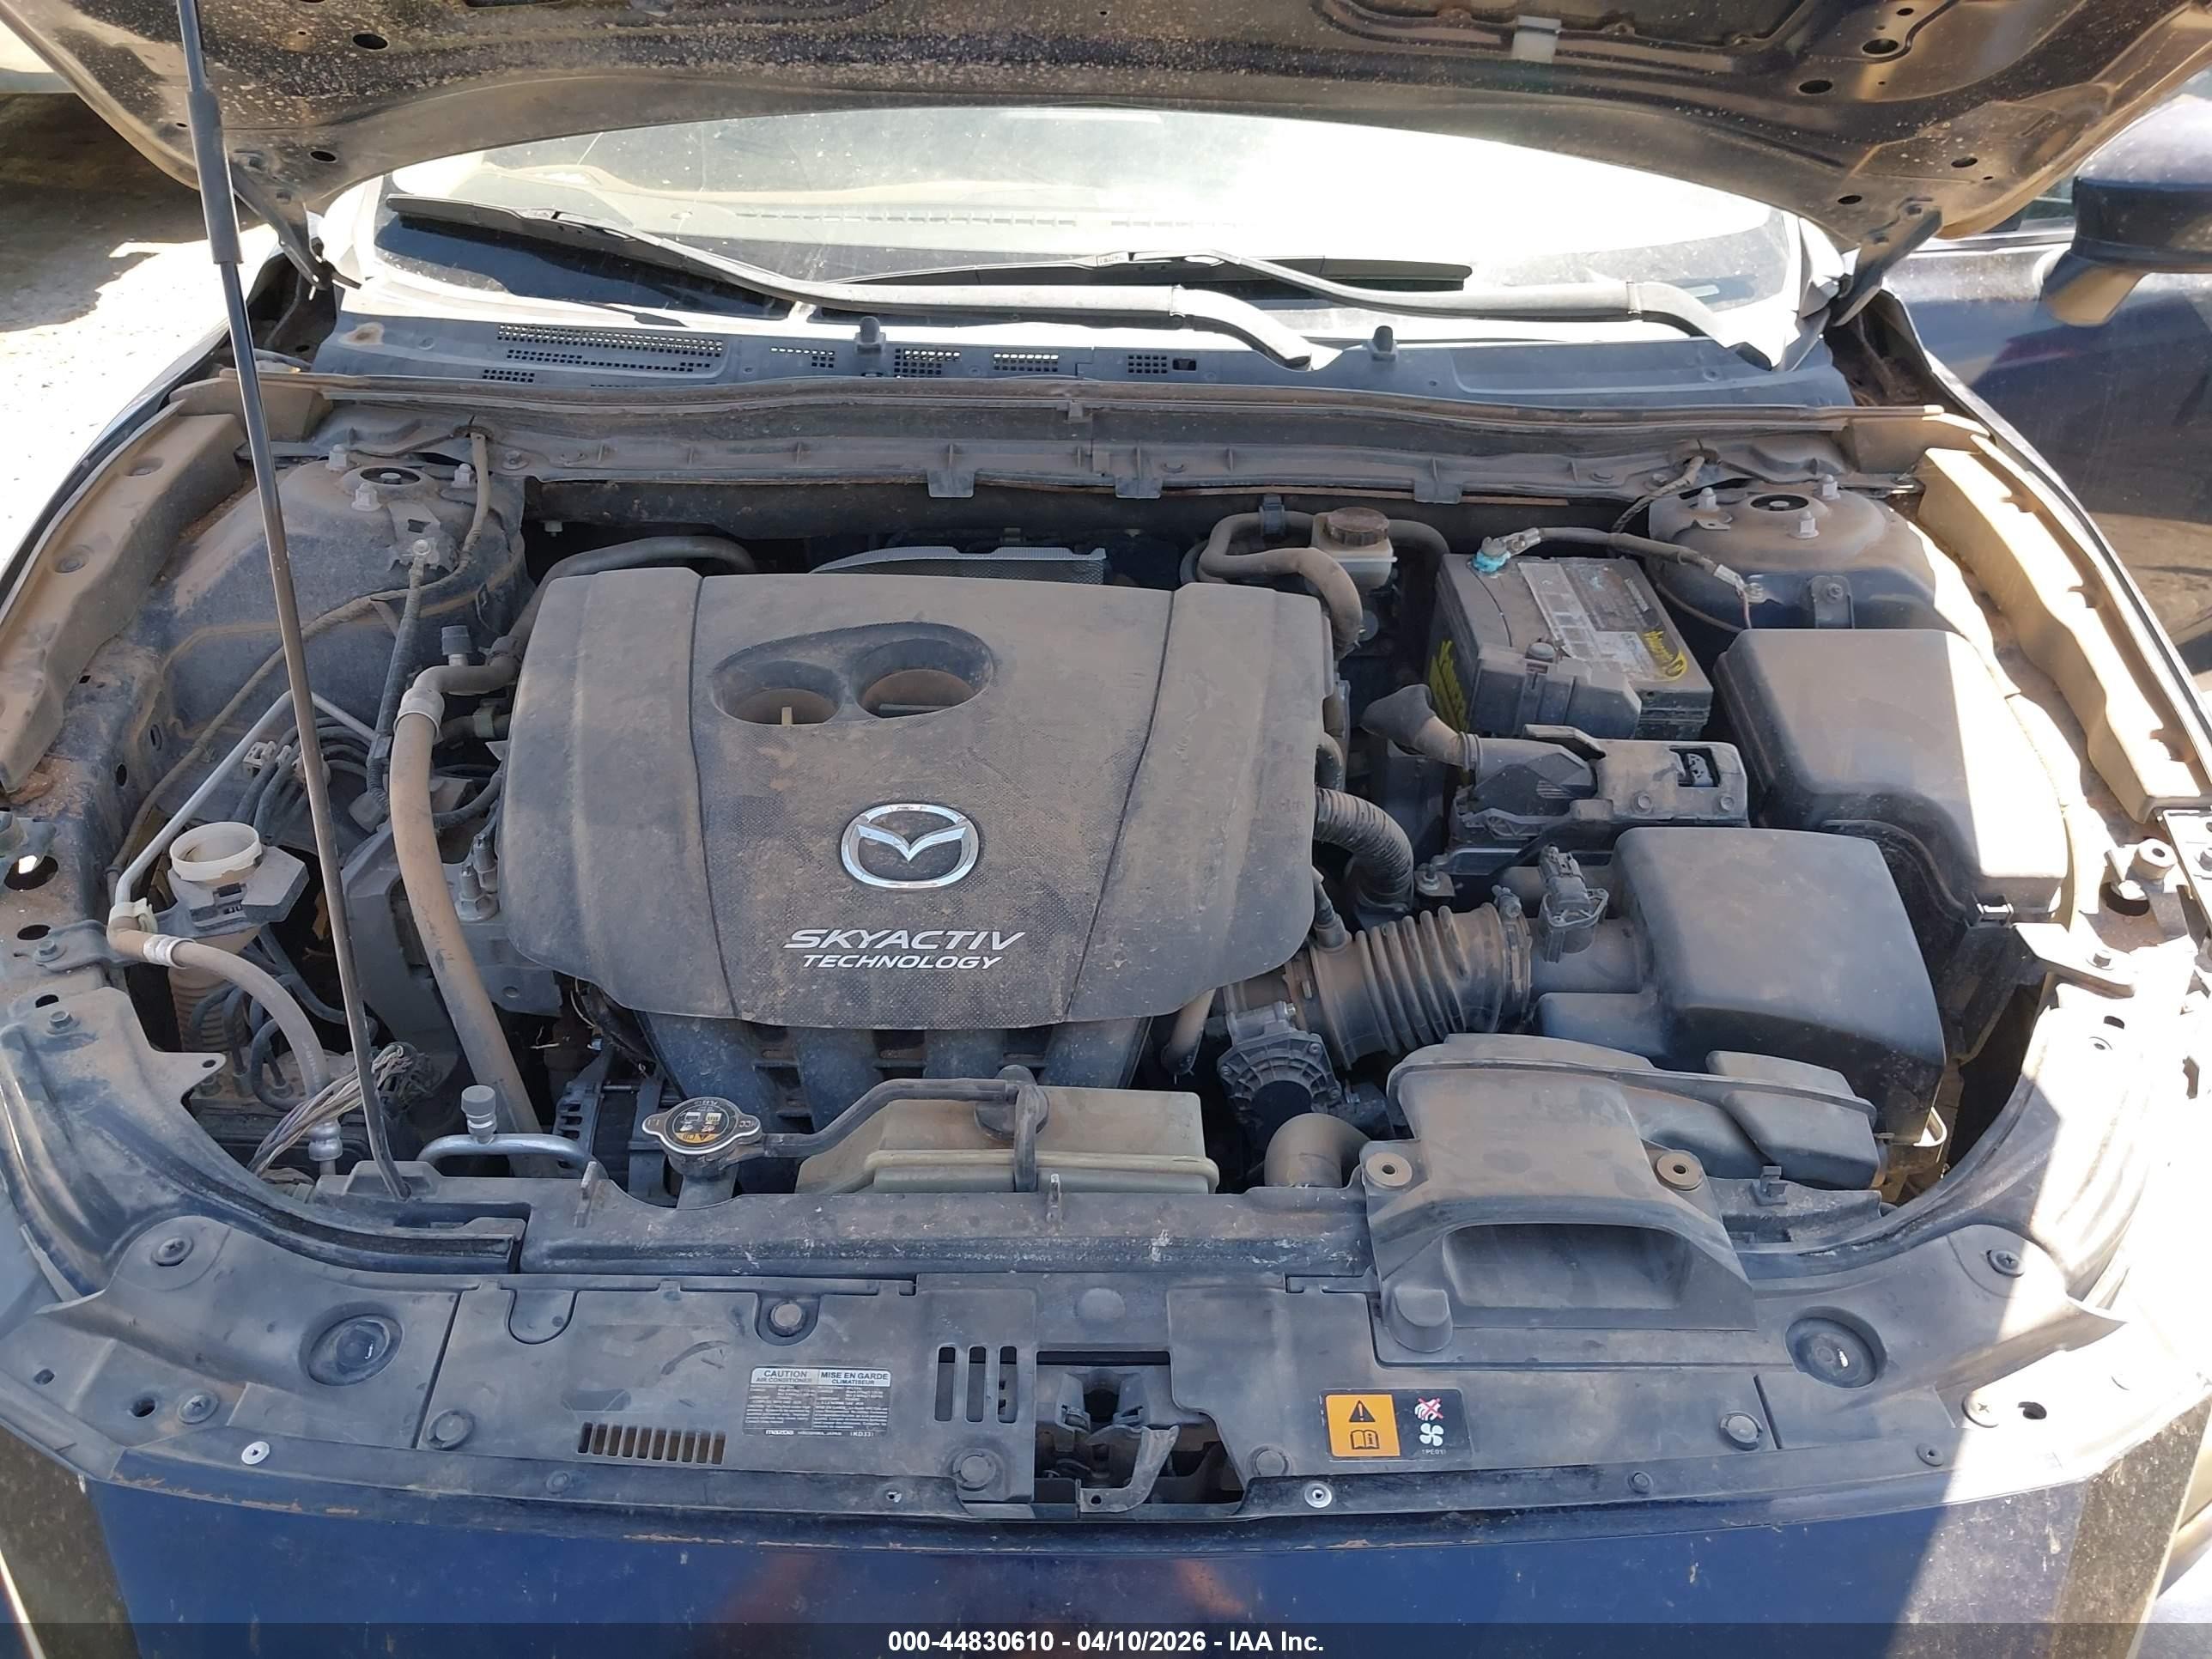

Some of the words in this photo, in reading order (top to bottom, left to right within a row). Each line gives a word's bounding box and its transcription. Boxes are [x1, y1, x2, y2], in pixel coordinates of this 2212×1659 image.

[783, 929, 1026, 951] SKYACTIV
[802, 955, 1003, 970] TECHNOLOGY
[764, 1370, 808, 1378] CAUTION
